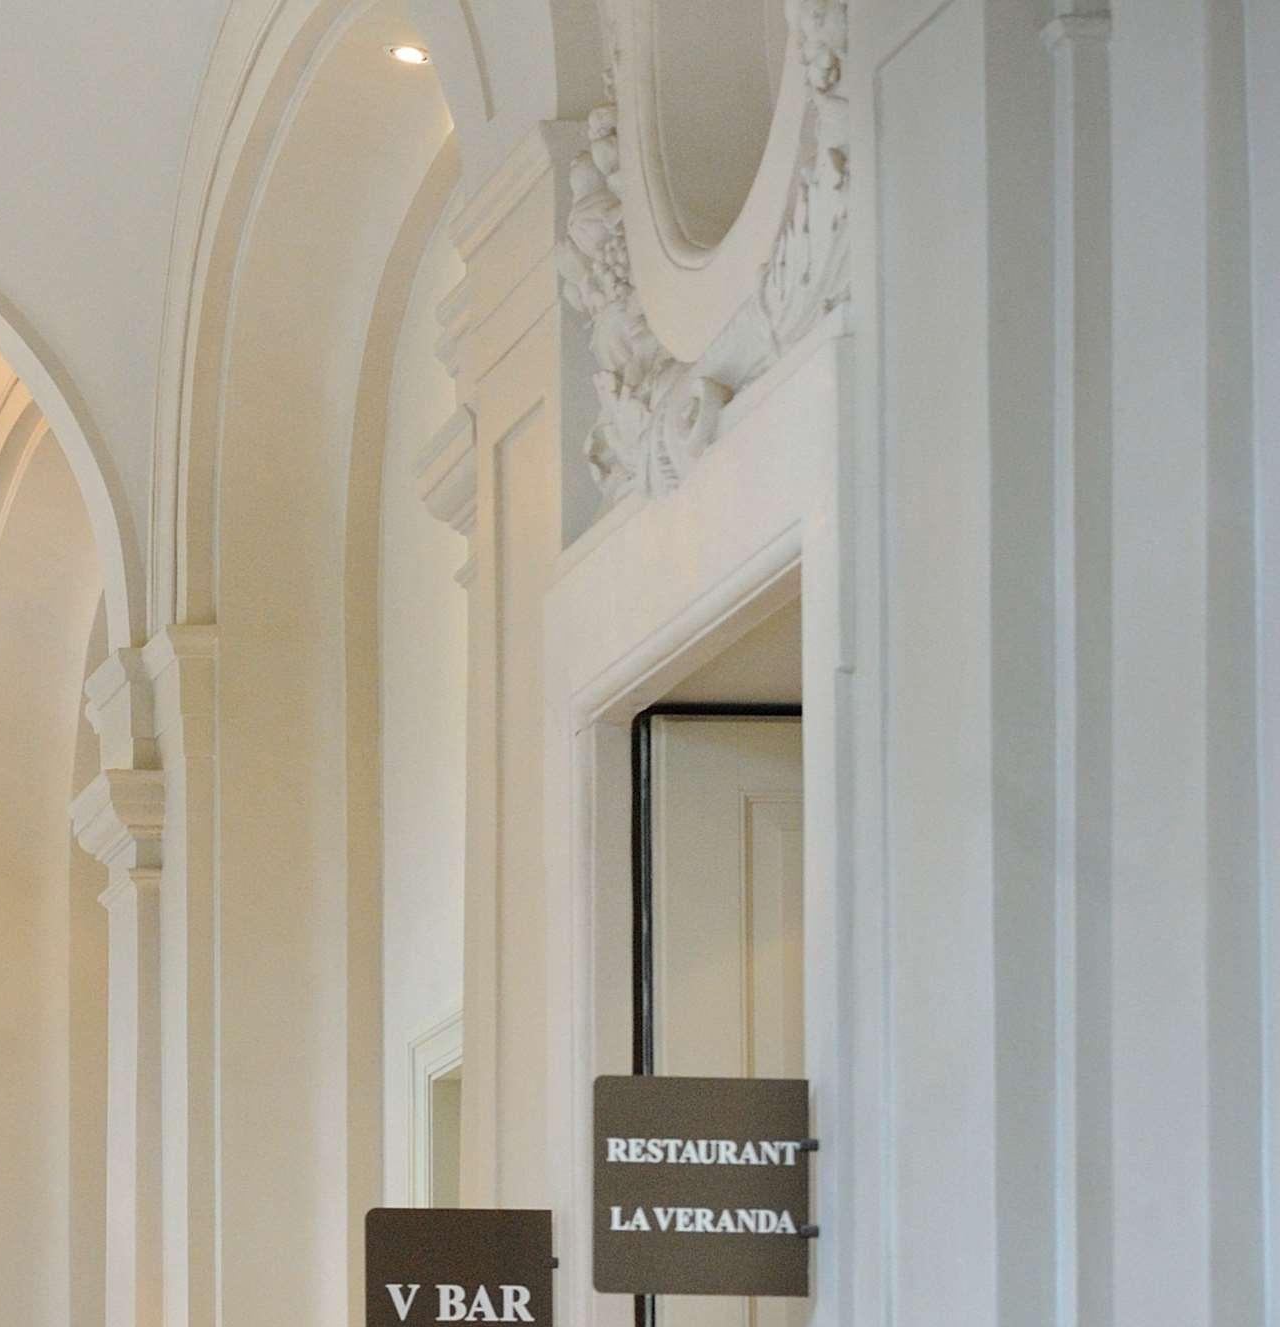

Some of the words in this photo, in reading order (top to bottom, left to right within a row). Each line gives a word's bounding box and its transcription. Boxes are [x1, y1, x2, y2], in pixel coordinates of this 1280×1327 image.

[605, 1136, 800, 1167] RESTAURANT
[609, 1205, 647, 1233] LA
[652, 1206, 798, 1236] VERANDA
[384, 1283, 422, 1323] V
[434, 1284, 537, 1323] BAR
